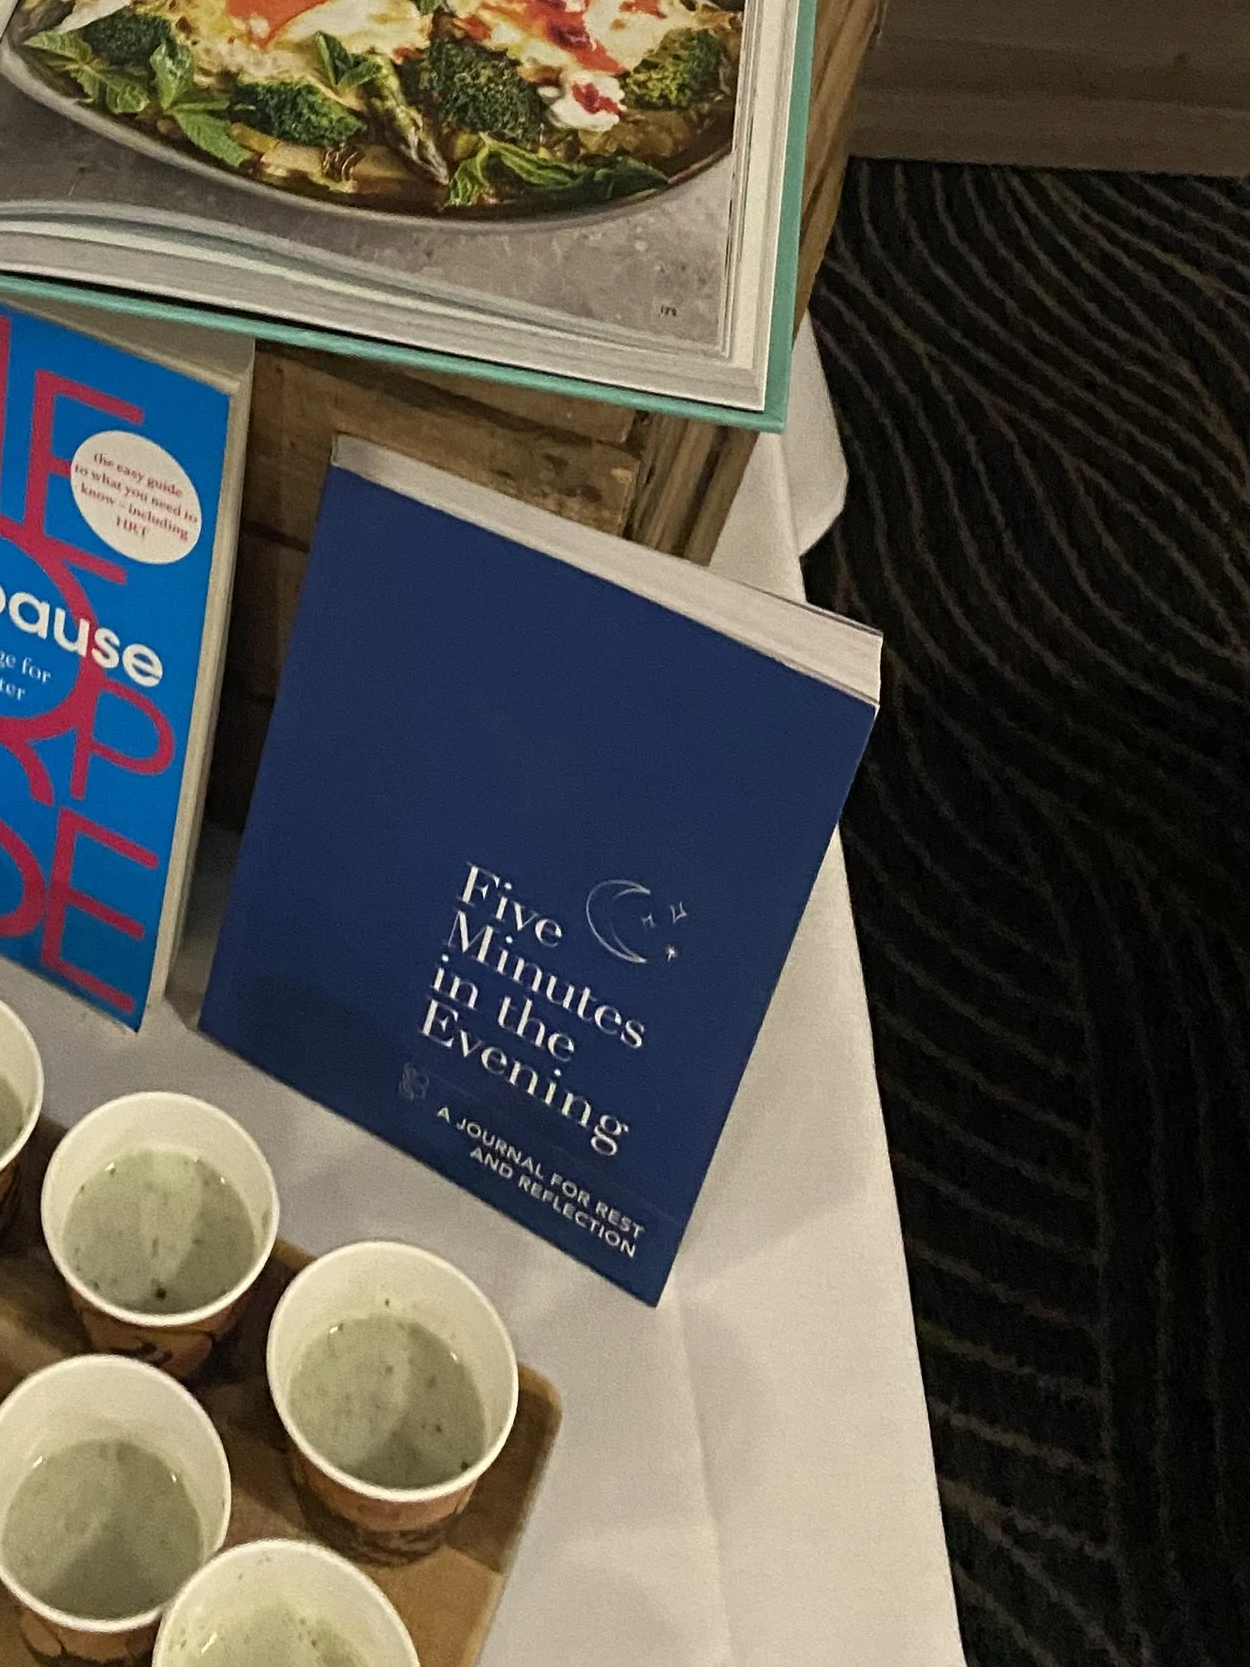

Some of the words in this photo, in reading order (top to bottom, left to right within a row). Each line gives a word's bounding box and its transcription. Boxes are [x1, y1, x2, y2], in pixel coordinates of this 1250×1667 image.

[75, 464, 88, 476] to
[91, 472, 122, 490] what
[125, 485, 148, 502] you
[151, 498, 181, 516] need
[184, 510, 198, 523] to
[80, 482, 115, 505] know
[128, 503, 188, 542] including
[94, 453, 114, 467] the
[117, 464, 144, 483] easy
[147, 478, 184, 498] guide
[22, 656, 51, 683] for
[456, 860, 564, 949] Five
[430, 953, 479, 1012] in
[495, 993, 576, 1063] the
[446, 908, 647, 1050] Minutes
[419, 997, 631, 1157] Evening
[435, 1105, 452, 1124] A
[455, 1117, 546, 1181] JOURNAL
[549, 1172, 591, 1208] FOR
[595, 1199, 645, 1239] REST
[469, 1146, 515, 1181] AND
[517, 1174, 639, 1259] REFLECTION
